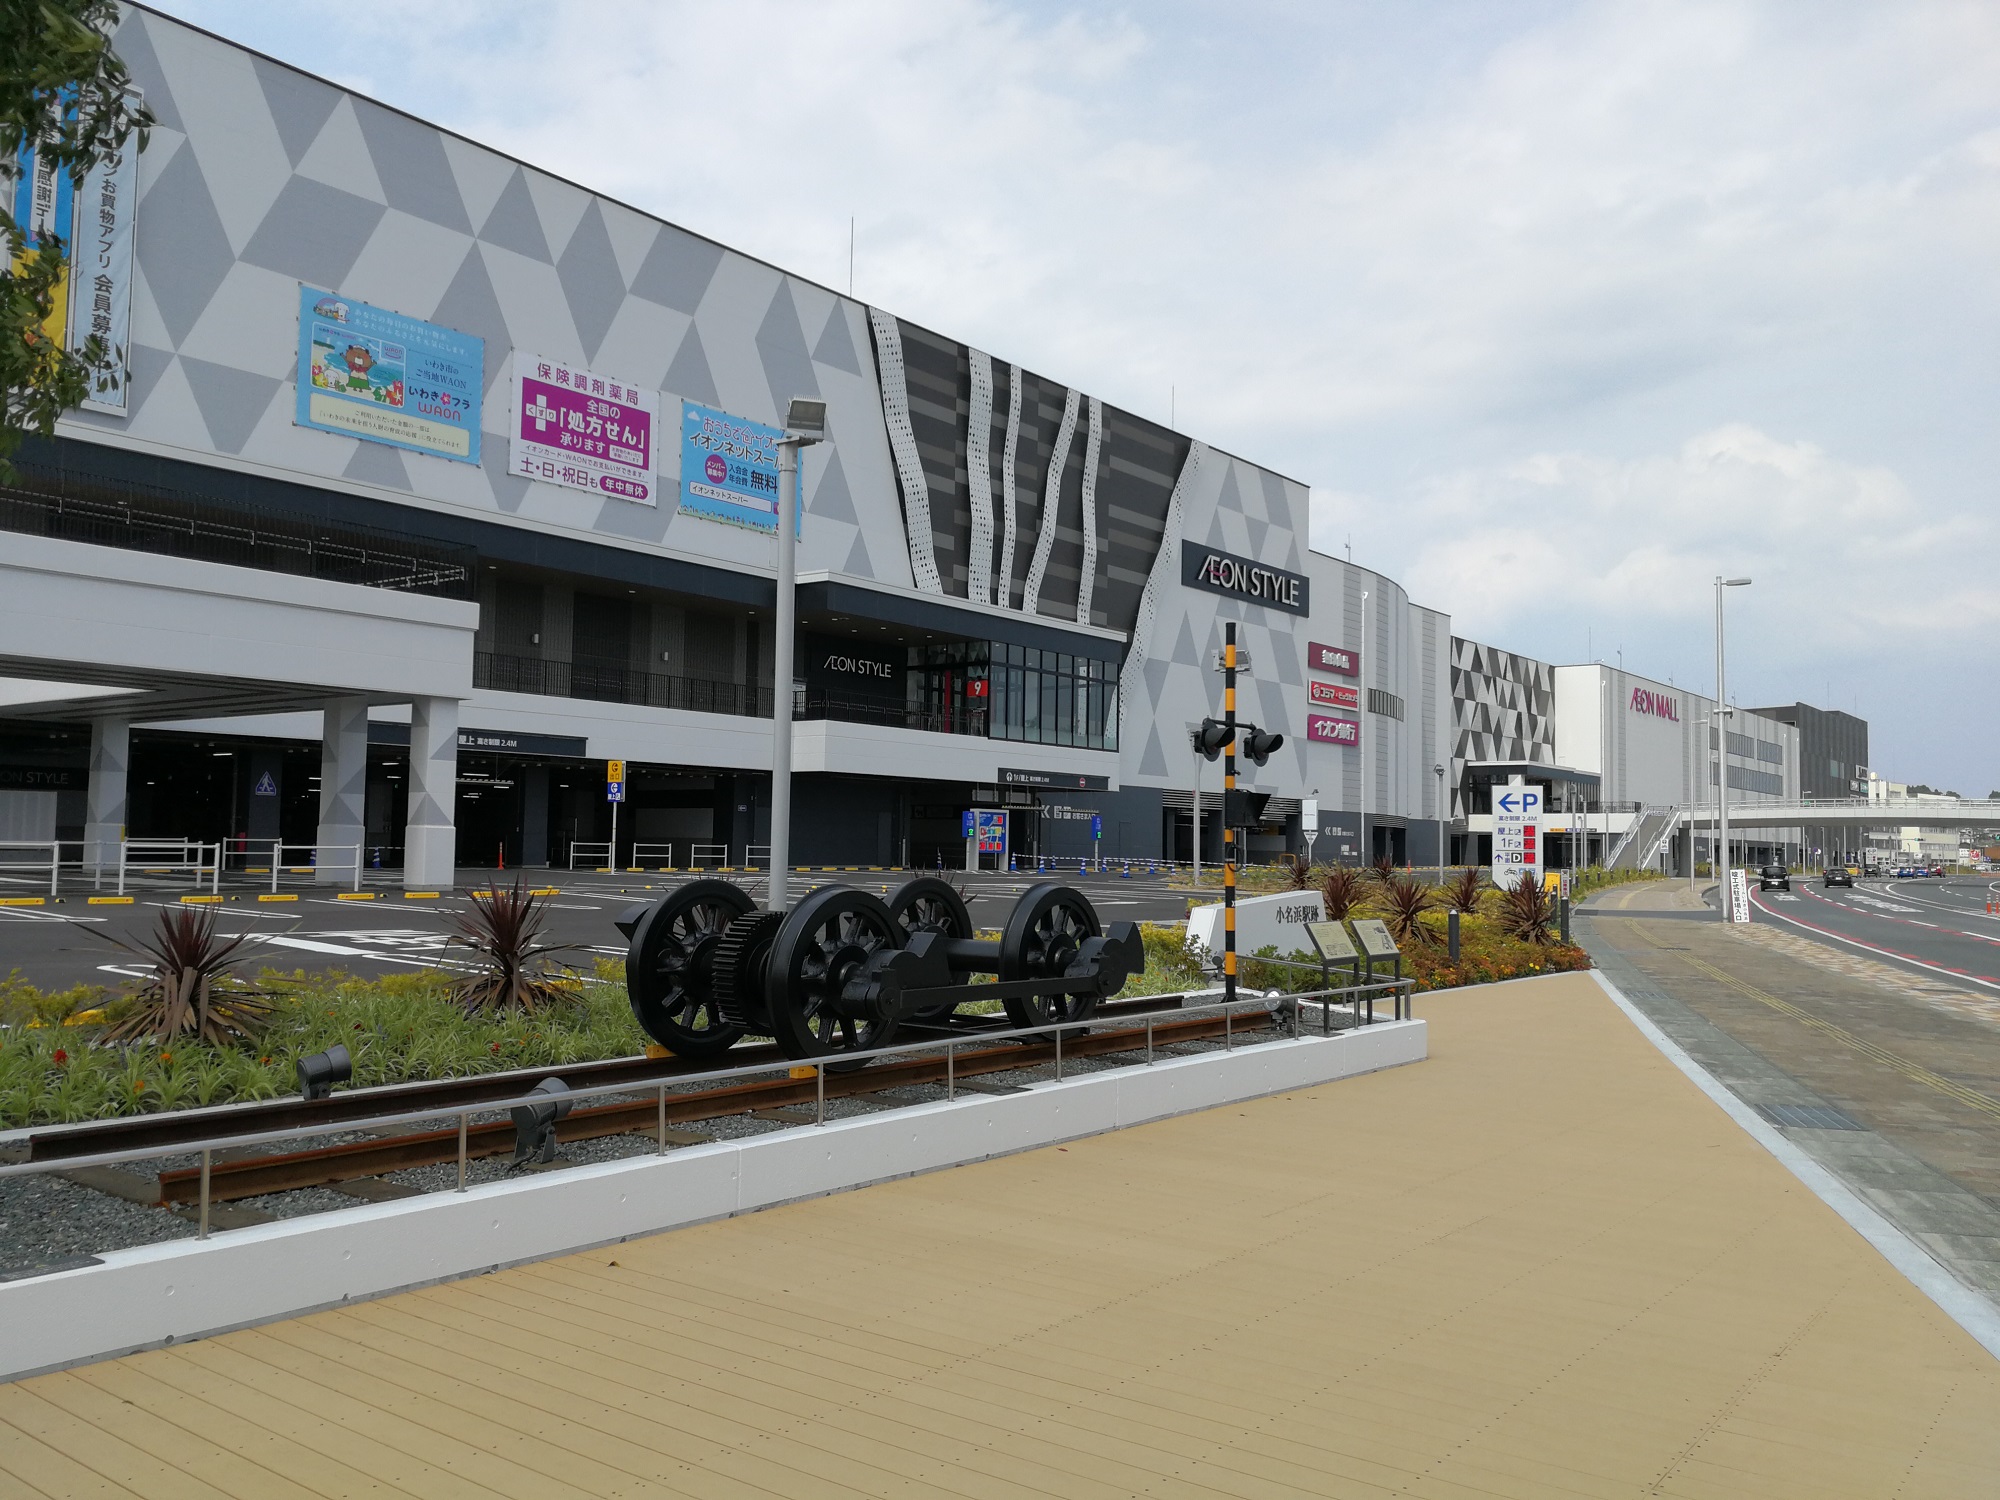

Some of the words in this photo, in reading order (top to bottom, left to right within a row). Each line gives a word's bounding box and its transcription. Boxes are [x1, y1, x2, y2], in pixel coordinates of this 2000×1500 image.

[538, 362, 638, 405] 保険調剤薬局
[418, 401, 461, 421] WAON
[587, 400, 620, 419] 全国の
[559, 407, 645, 449] 「処方せん」
[560, 431, 605, 454] 承ります
[728, 463, 748, 476] 入会金
[605, 478, 643, 497] 年中無休
[728, 474, 748, 487] 年会費
[751, 470, 778, 495] 無料
[1250, 567, 1299, 606] STYLE
[858, 659, 891, 678] STYLE
[974, 681, 981, 695] 9
[1656, 693, 1679, 722] MALL
[1315, 720, 1355, 740] イオン銀行
[501, 739, 517, 747] 2.4M
[26, 771, 69, 785] STYLE
[1522, 793, 1538, 812] P
[1498, 827, 1513, 835] 屋上
[1501, 838, 1513, 848] 1F
[1512, 853, 1520, 862] D
[1276, 904, 1320, 924] 小名浜駅跡
